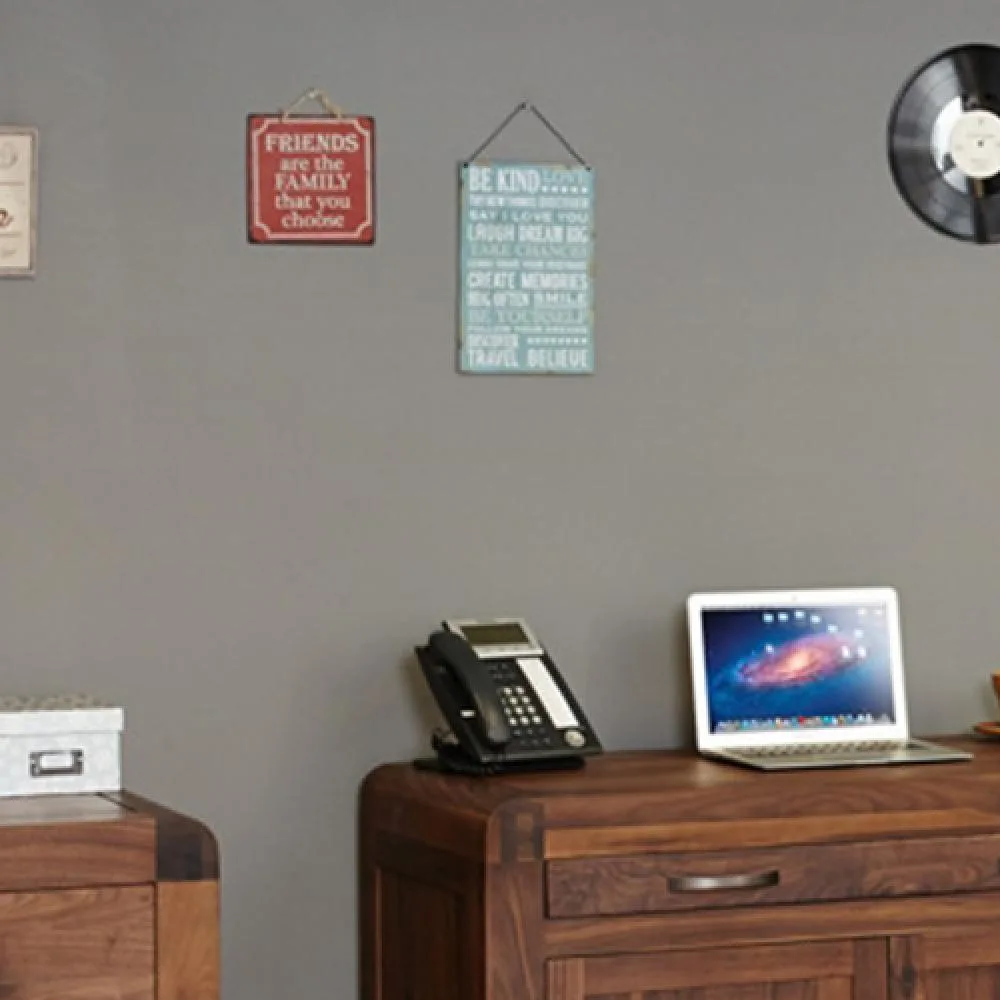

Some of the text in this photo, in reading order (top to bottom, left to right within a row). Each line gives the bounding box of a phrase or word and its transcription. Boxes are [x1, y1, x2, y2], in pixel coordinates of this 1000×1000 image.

[265, 132, 359, 152] FRIENDS
[315, 154, 344, 171] the
[275, 172, 351, 190] FAMILY
[275, 192, 351, 216] that you
